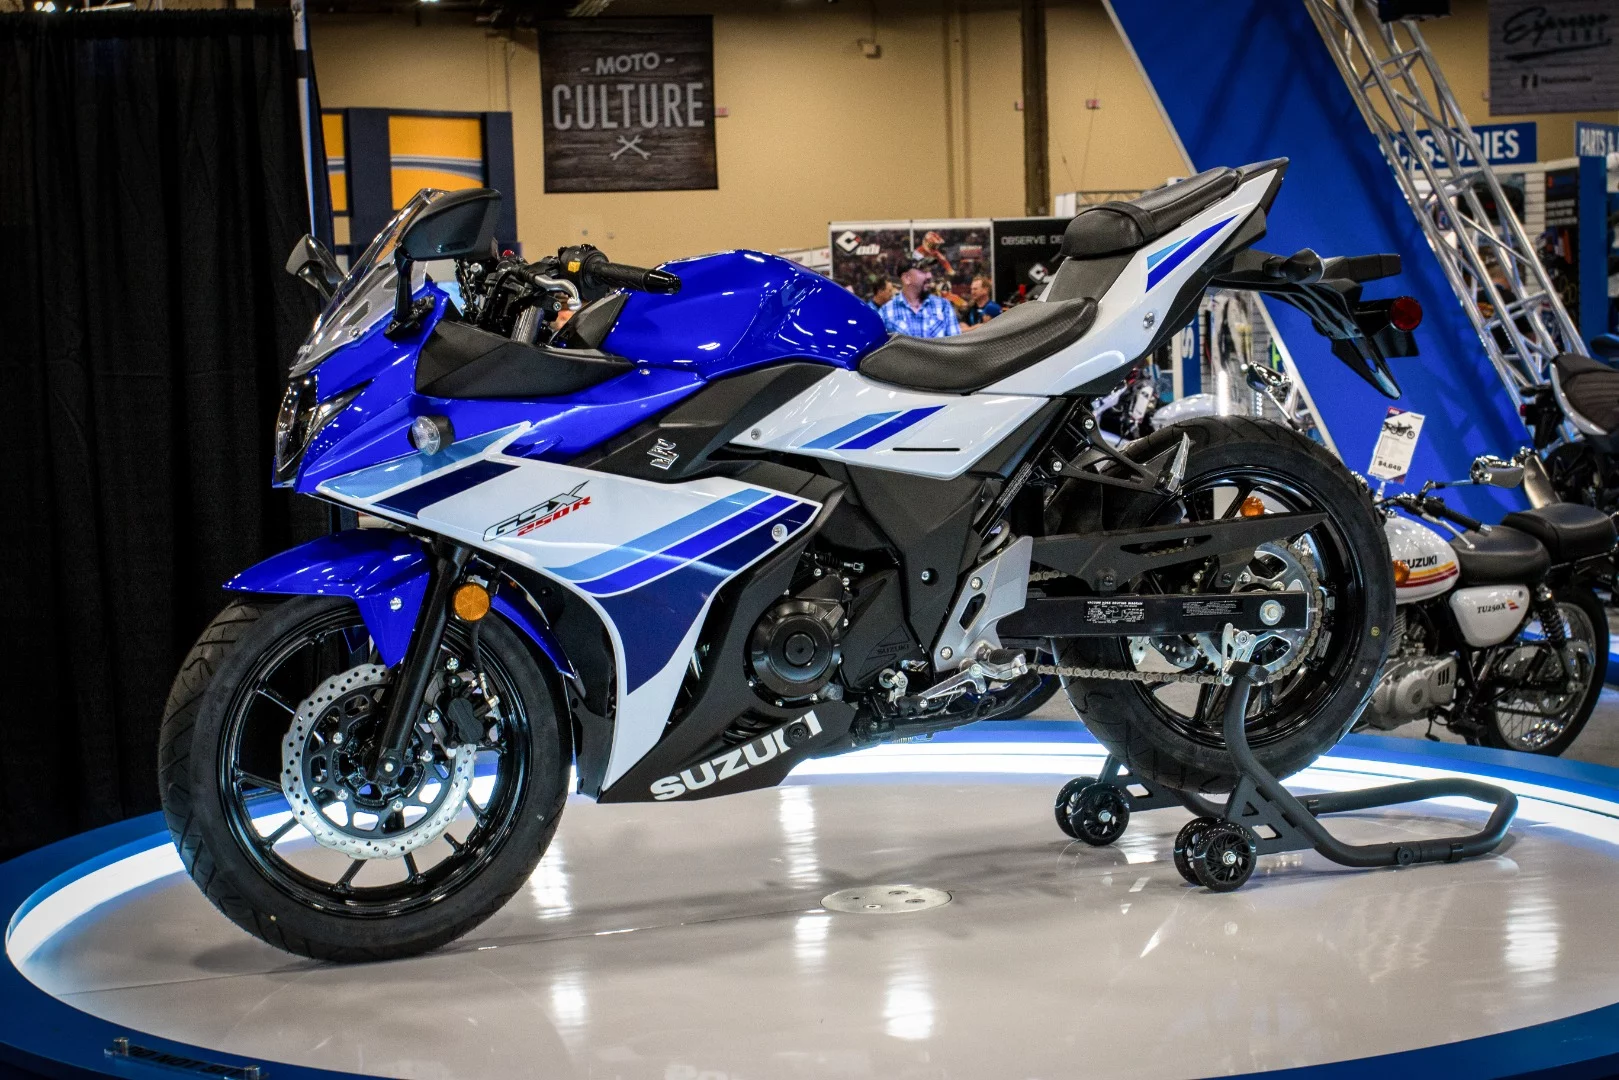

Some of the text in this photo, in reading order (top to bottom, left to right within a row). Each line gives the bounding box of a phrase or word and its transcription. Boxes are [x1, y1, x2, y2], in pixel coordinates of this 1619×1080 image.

[596, 52, 660, 75] MOTO
[552, 82, 705, 130] CULTURE
[1579, 128, 1606, 156] PARTS
[1001, 235, 1046, 245] OBSERVE
[483, 480, 590, 541] GSX
[1477, 602, 1506, 614] TU250X
